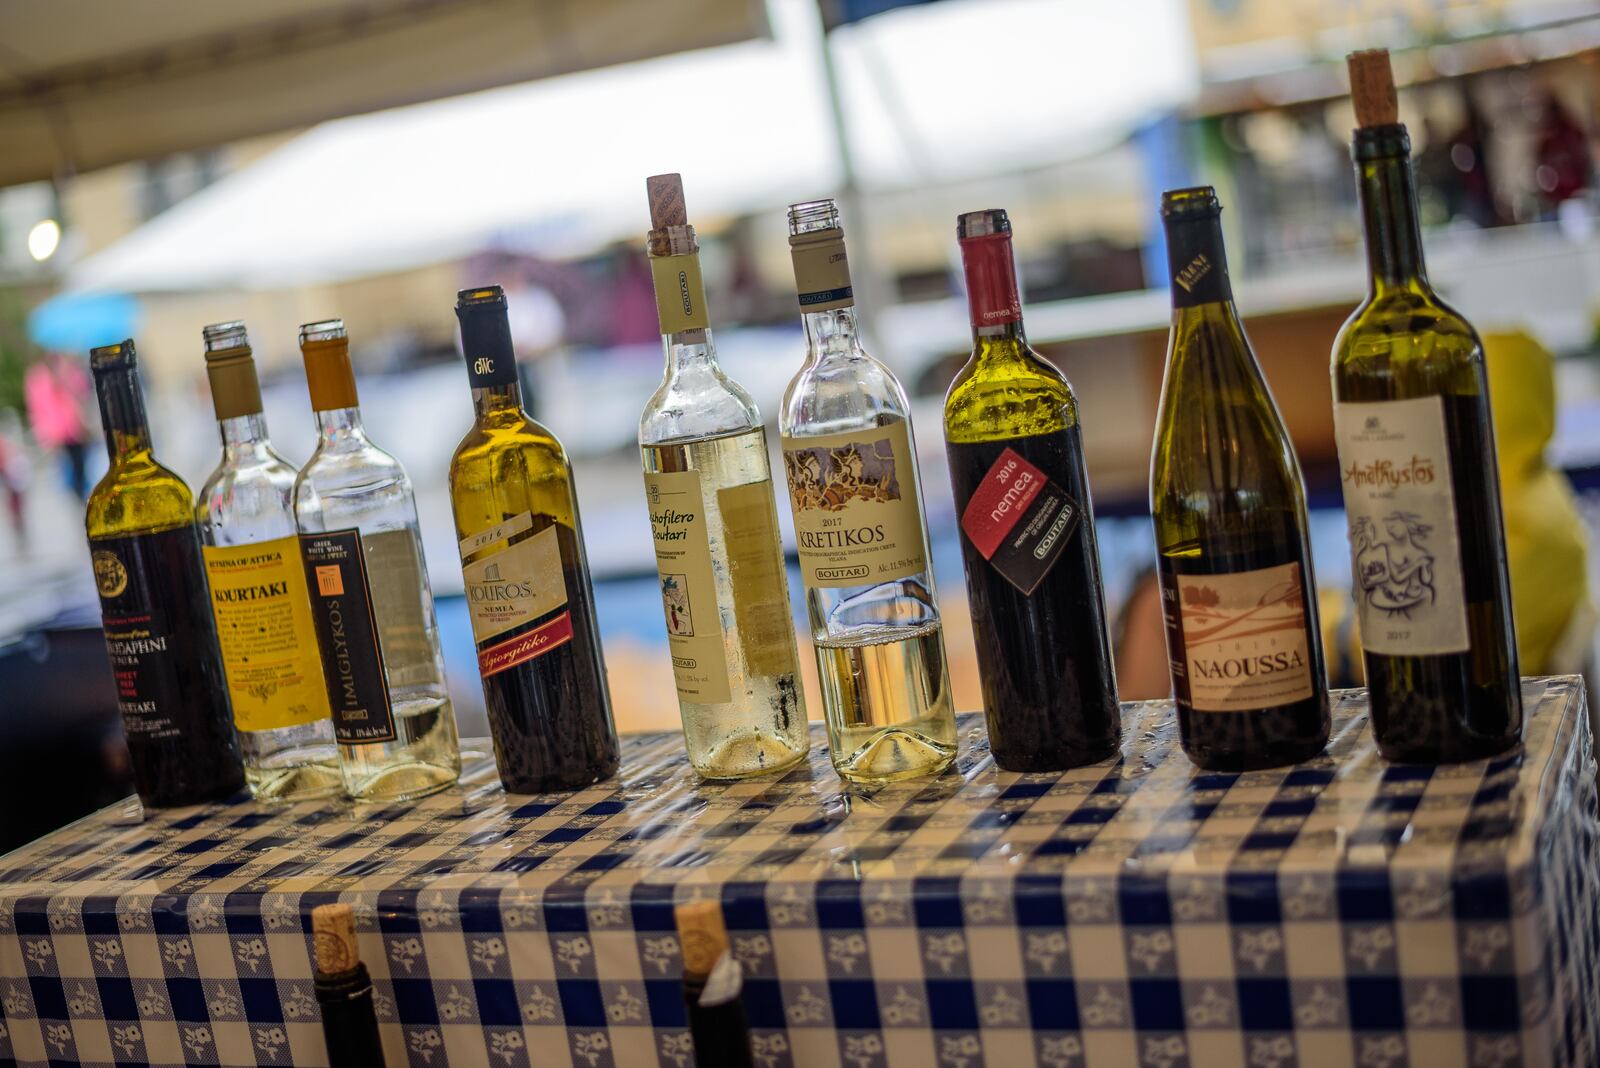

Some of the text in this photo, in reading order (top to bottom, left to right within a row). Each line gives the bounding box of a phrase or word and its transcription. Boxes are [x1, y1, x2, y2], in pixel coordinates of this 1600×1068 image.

[681, 272, 691, 314] BOUTARI
[984, 309, 1010, 320] nemea
[474, 357, 495, 375] GWC
[996, 460, 1017, 484] 2016
[991, 471, 1033, 522] nemea
[823, 517, 842, 527] 2017
[1037, 507, 1071, 556] BOUTARI
[475, 528, 502, 546] 2016
[799, 525, 885, 549] KRETIKOS
[249, 552, 283, 565] ATTICA
[818, 567, 866, 578] BOUTARI
[215, 581, 288, 602] KOURTAKI
[1193, 650, 1304, 679] NAOUSSA
